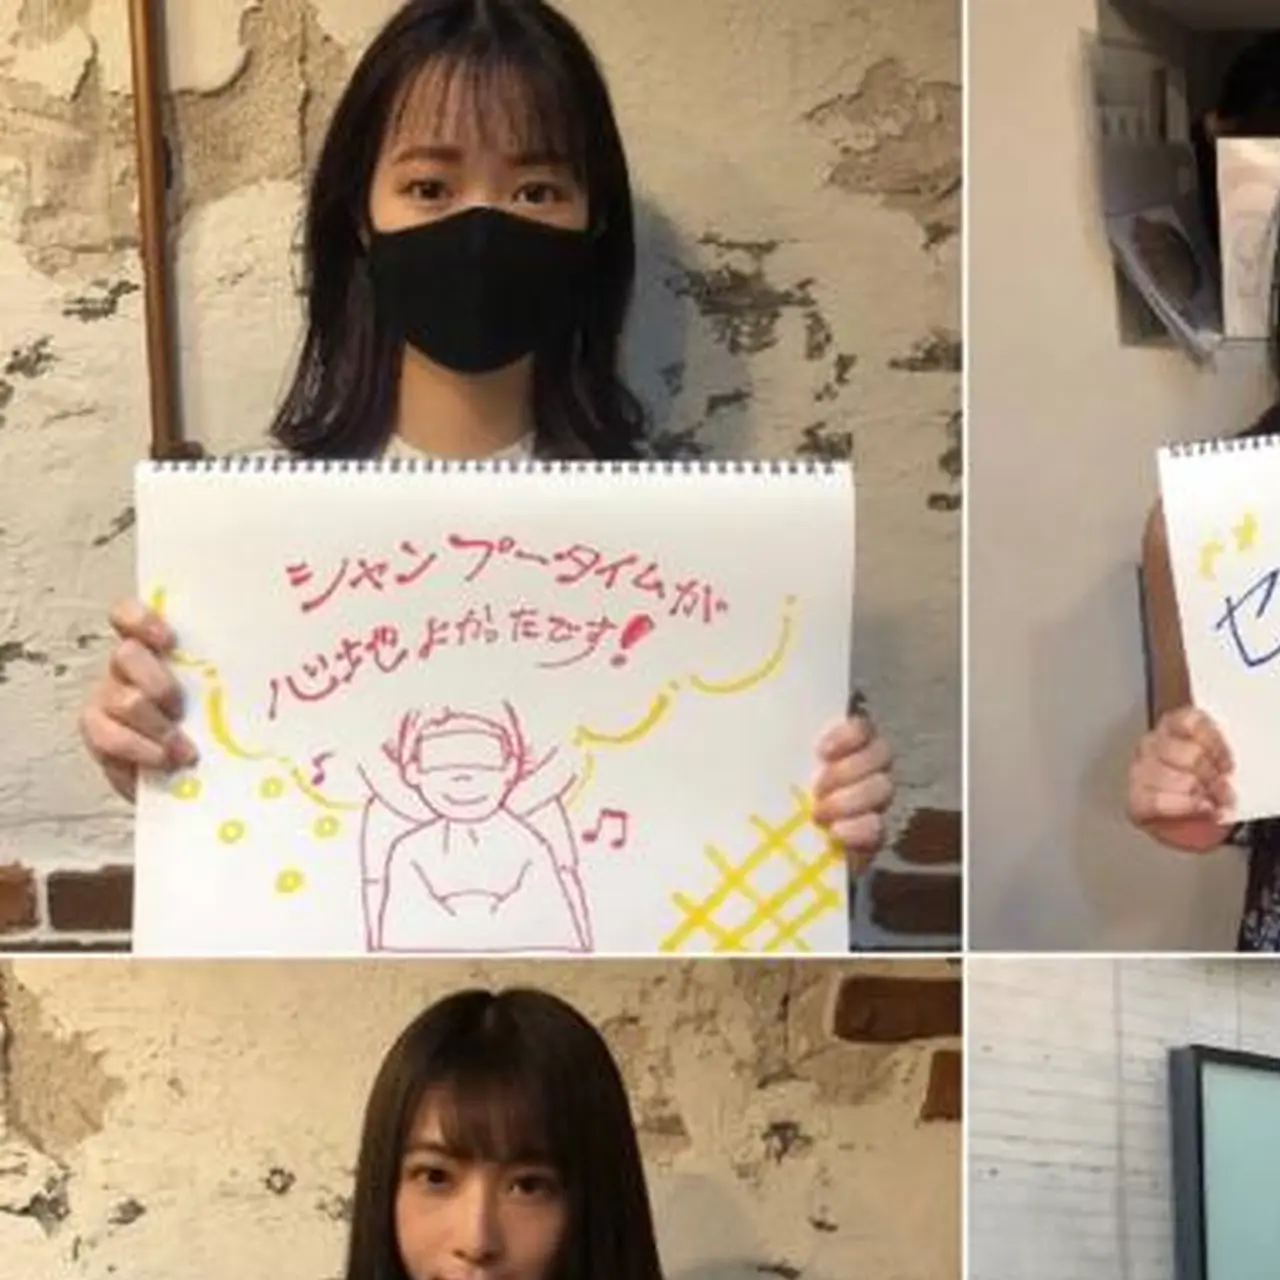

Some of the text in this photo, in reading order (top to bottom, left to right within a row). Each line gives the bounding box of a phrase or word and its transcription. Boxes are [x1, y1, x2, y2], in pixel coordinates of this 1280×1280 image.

[287, 532, 729, 624] シャンプータイムが
